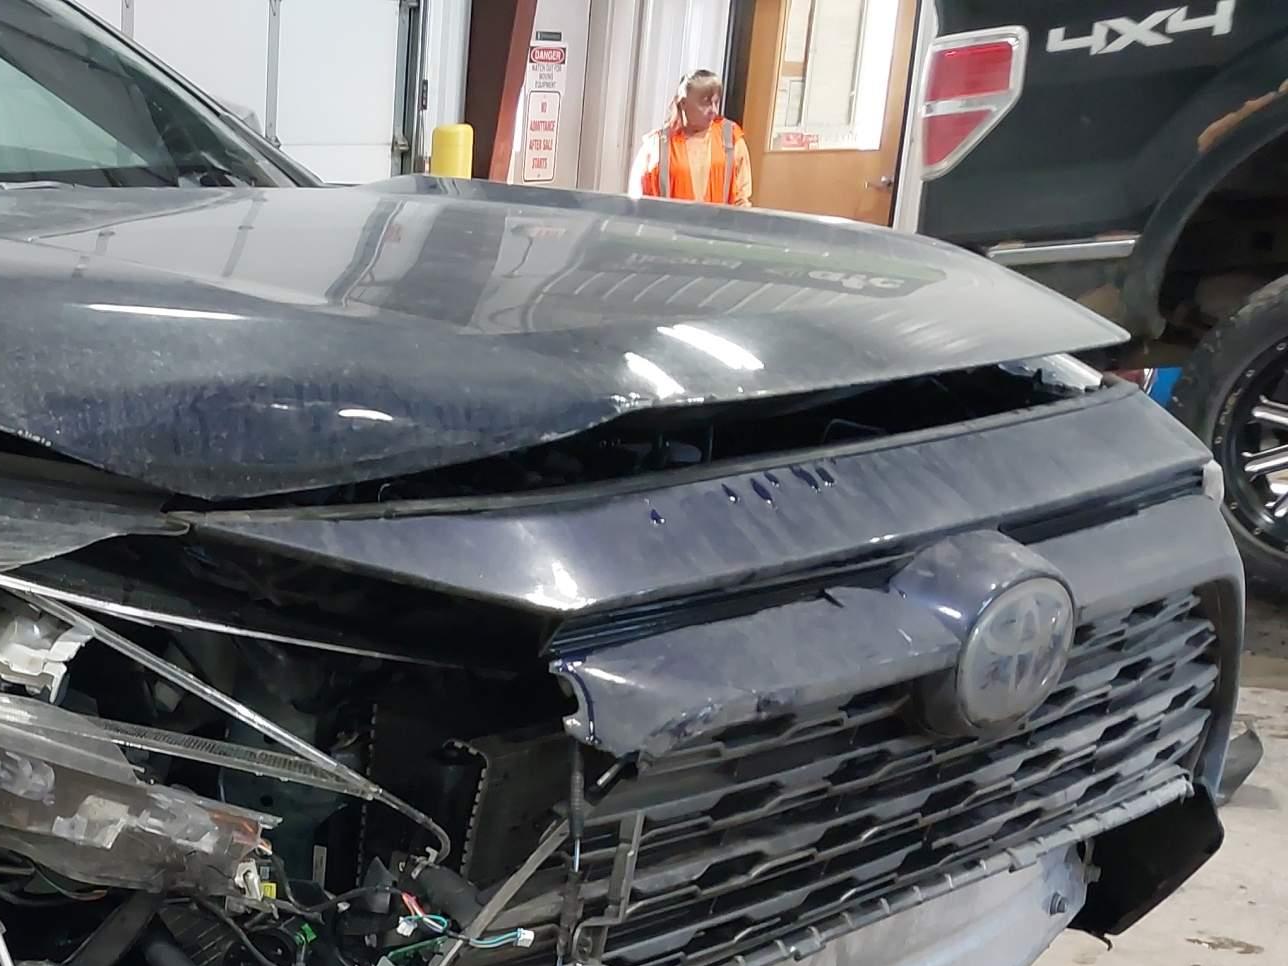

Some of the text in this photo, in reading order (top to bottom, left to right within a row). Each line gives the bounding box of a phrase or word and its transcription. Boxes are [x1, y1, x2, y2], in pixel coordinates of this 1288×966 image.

[534, 49, 562, 60] DANGER
[541, 102, 547, 112] NO
[530, 120, 555, 131] ADMITTANCE
[529, 139, 542, 150] AFTER
[532, 158, 548, 169] STARTS
